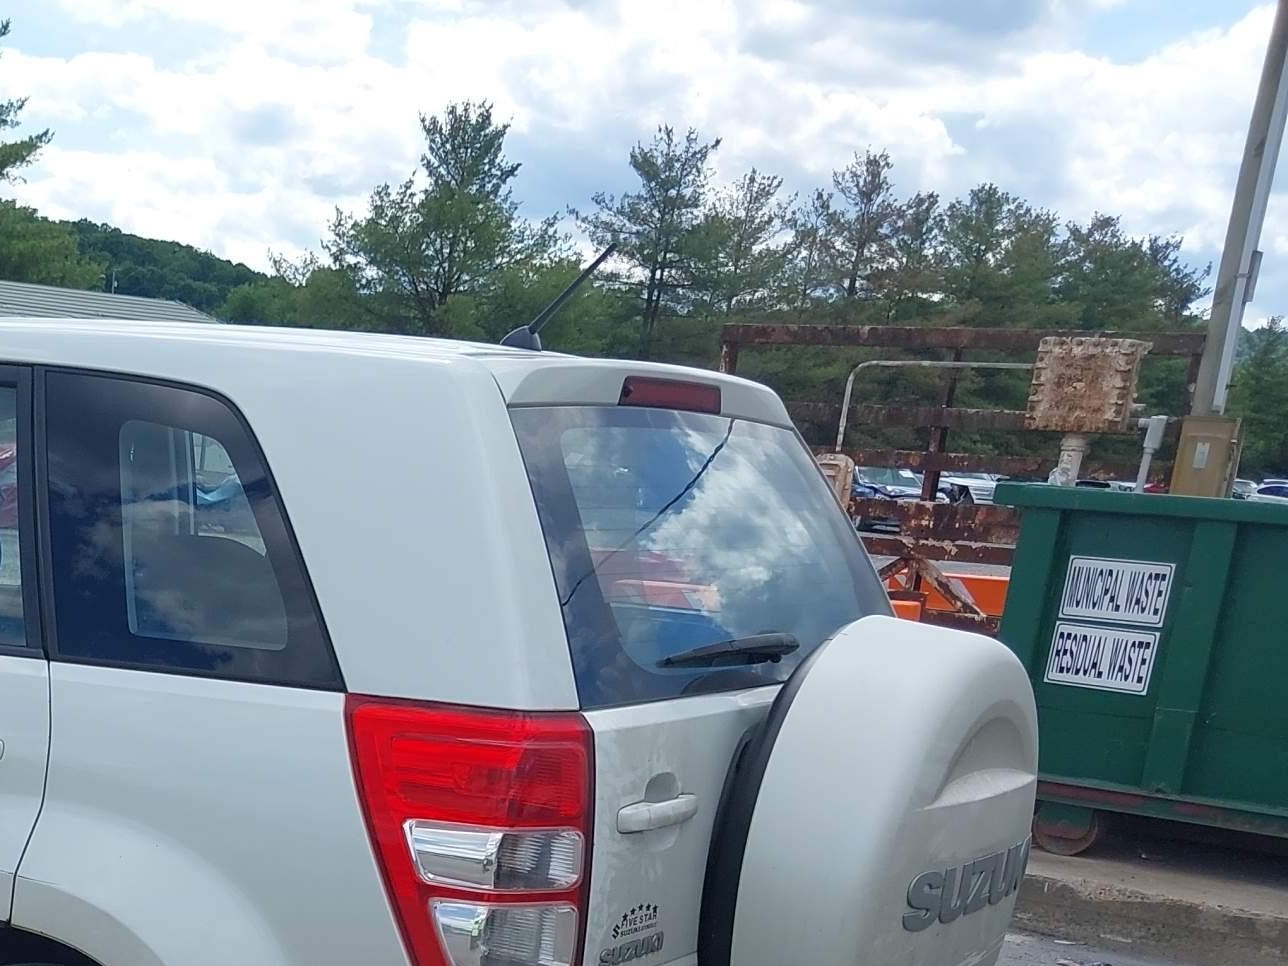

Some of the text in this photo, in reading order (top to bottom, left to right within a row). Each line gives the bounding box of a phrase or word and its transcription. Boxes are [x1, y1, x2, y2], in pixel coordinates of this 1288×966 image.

[1066, 566, 1168, 616] MUNICIPAL WASTE
[1052, 631, 1152, 684] RESIDUAL WASTE
[902, 834, 1032, 933] SUZUK
[621, 916, 638, 929] FIVE
[639, 912, 657, 924] STAR
